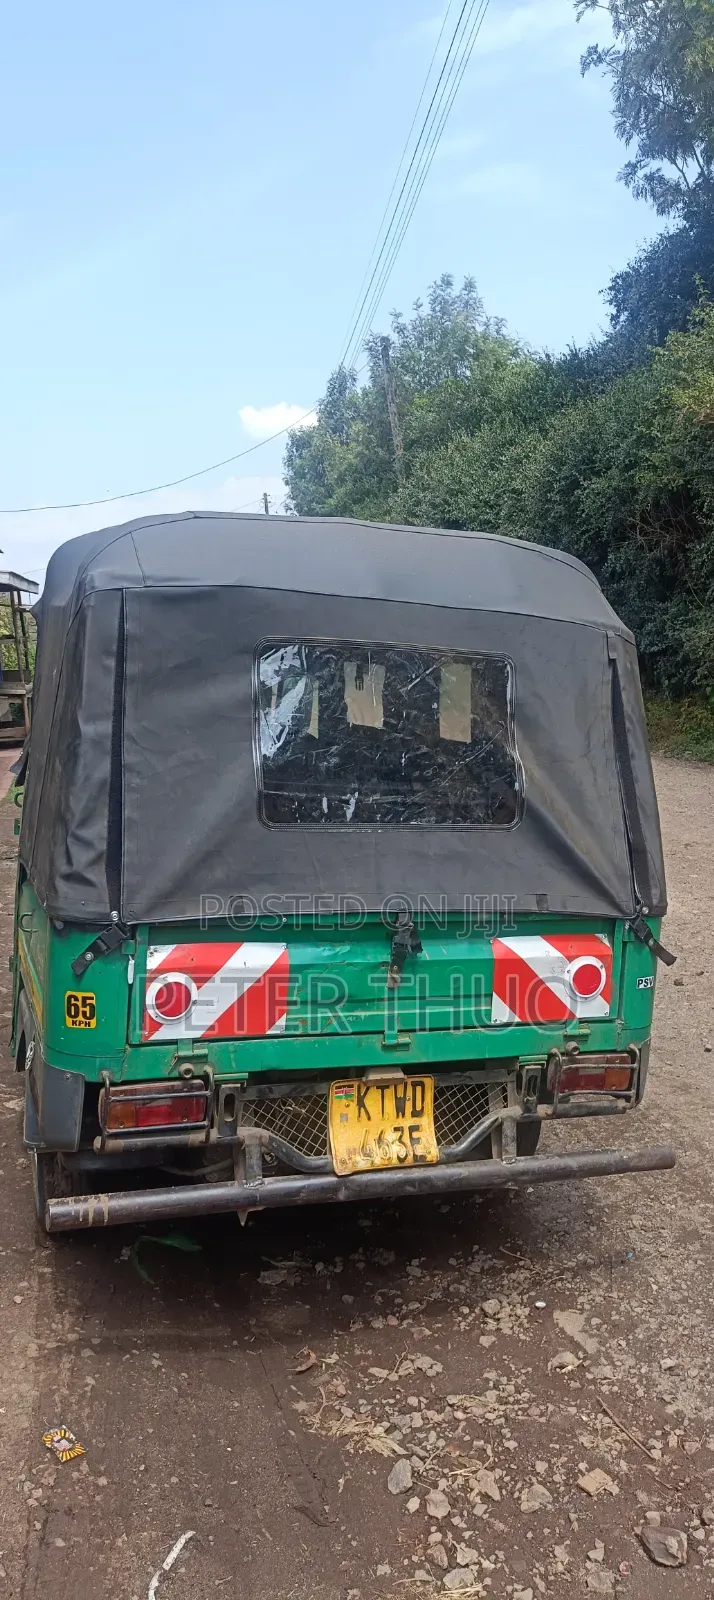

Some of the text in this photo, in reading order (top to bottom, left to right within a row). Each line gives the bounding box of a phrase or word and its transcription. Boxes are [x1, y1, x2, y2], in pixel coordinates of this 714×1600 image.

[66, 994, 96, 1020] 65
[71, 1019, 91, 1028] KPH
[356, 1080, 426, 1122] KTWD
[359, 1124, 429, 1166] 463E
